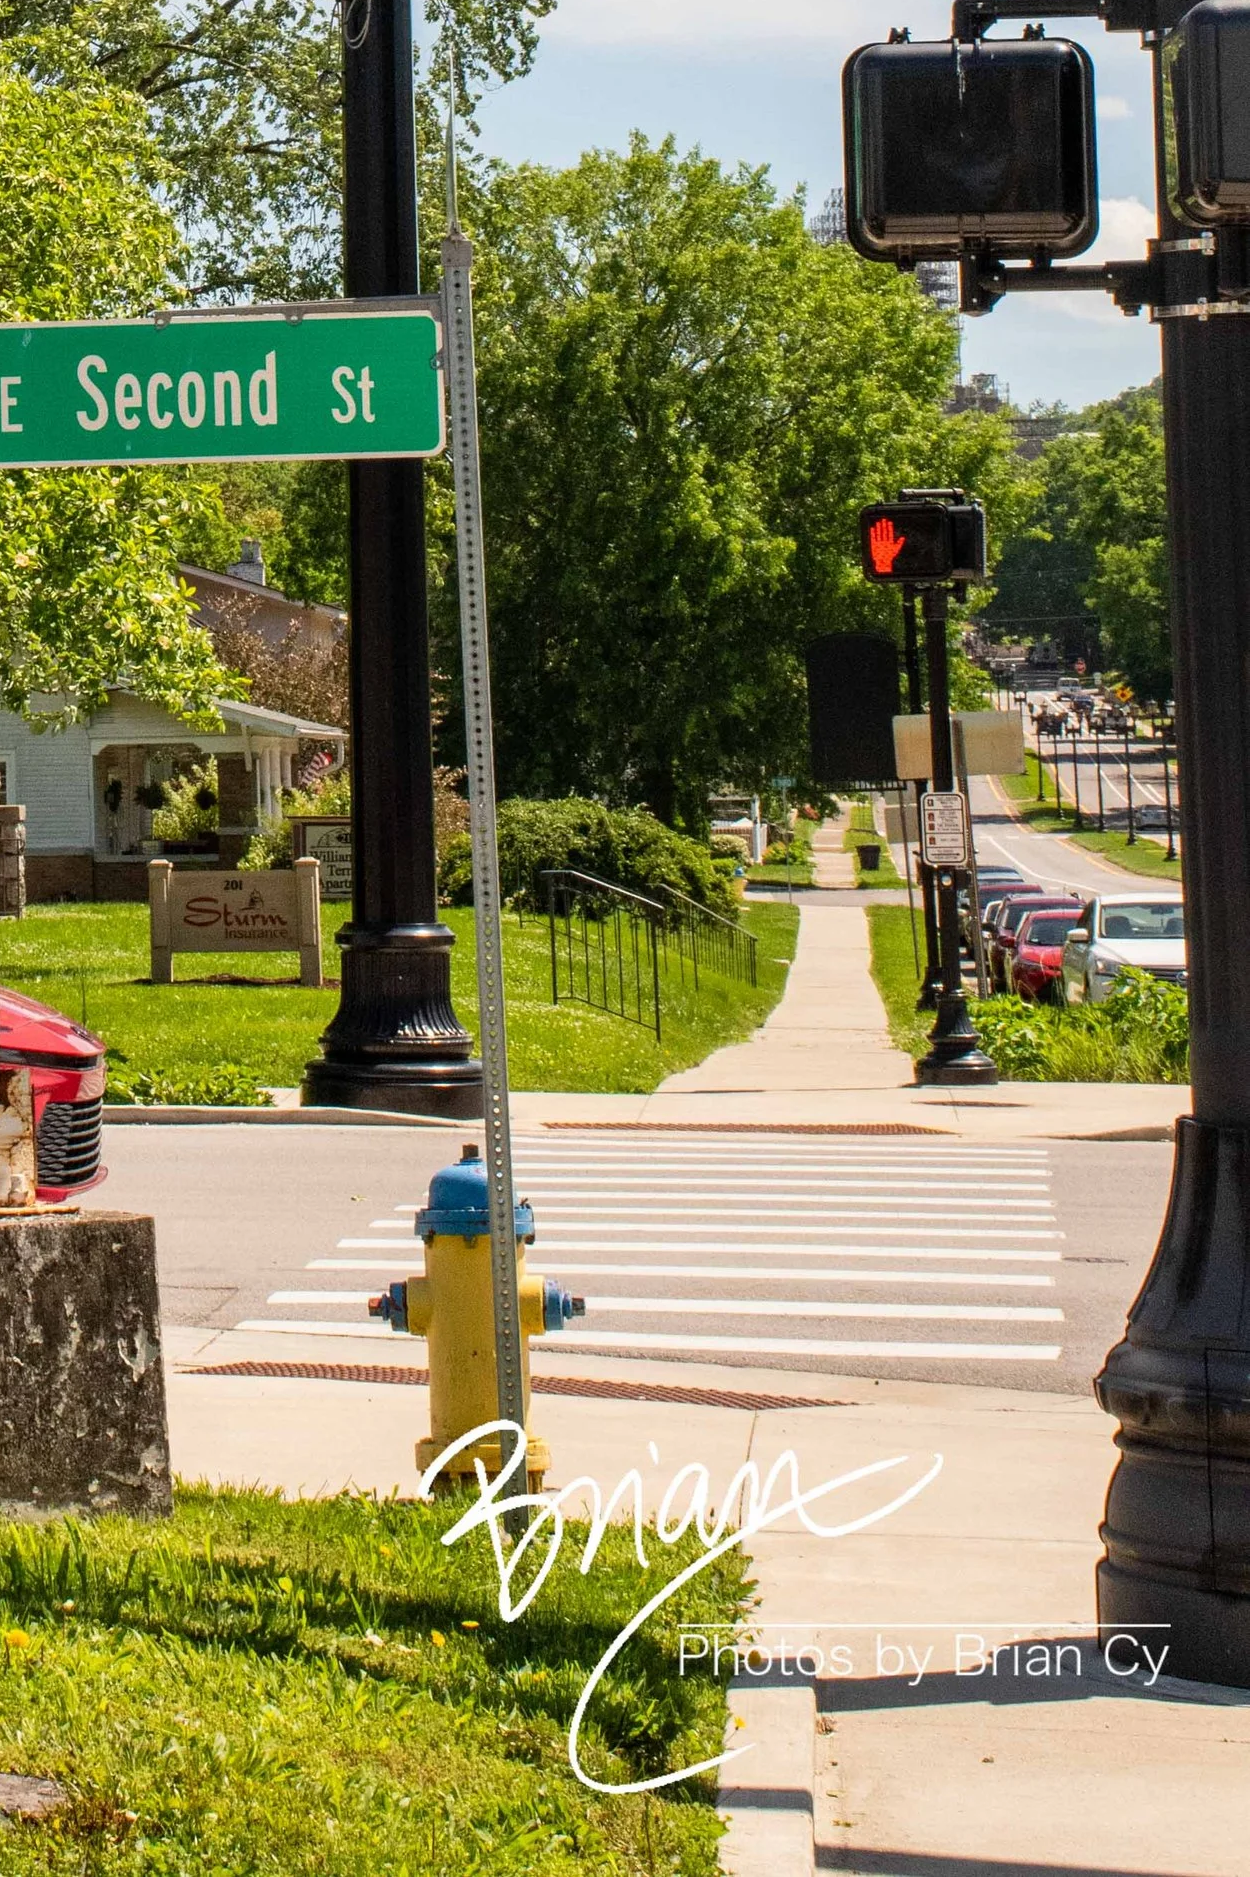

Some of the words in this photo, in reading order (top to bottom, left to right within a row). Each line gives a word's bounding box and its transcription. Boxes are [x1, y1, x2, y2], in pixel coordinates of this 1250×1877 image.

[0, 376, 23, 433] E
[76, 350, 278, 431] Second
[331, 365, 376, 424] St
[223, 879, 243, 890] 201
[183, 896, 288, 927] Sturm
[225, 927, 288, 939] Insurance
